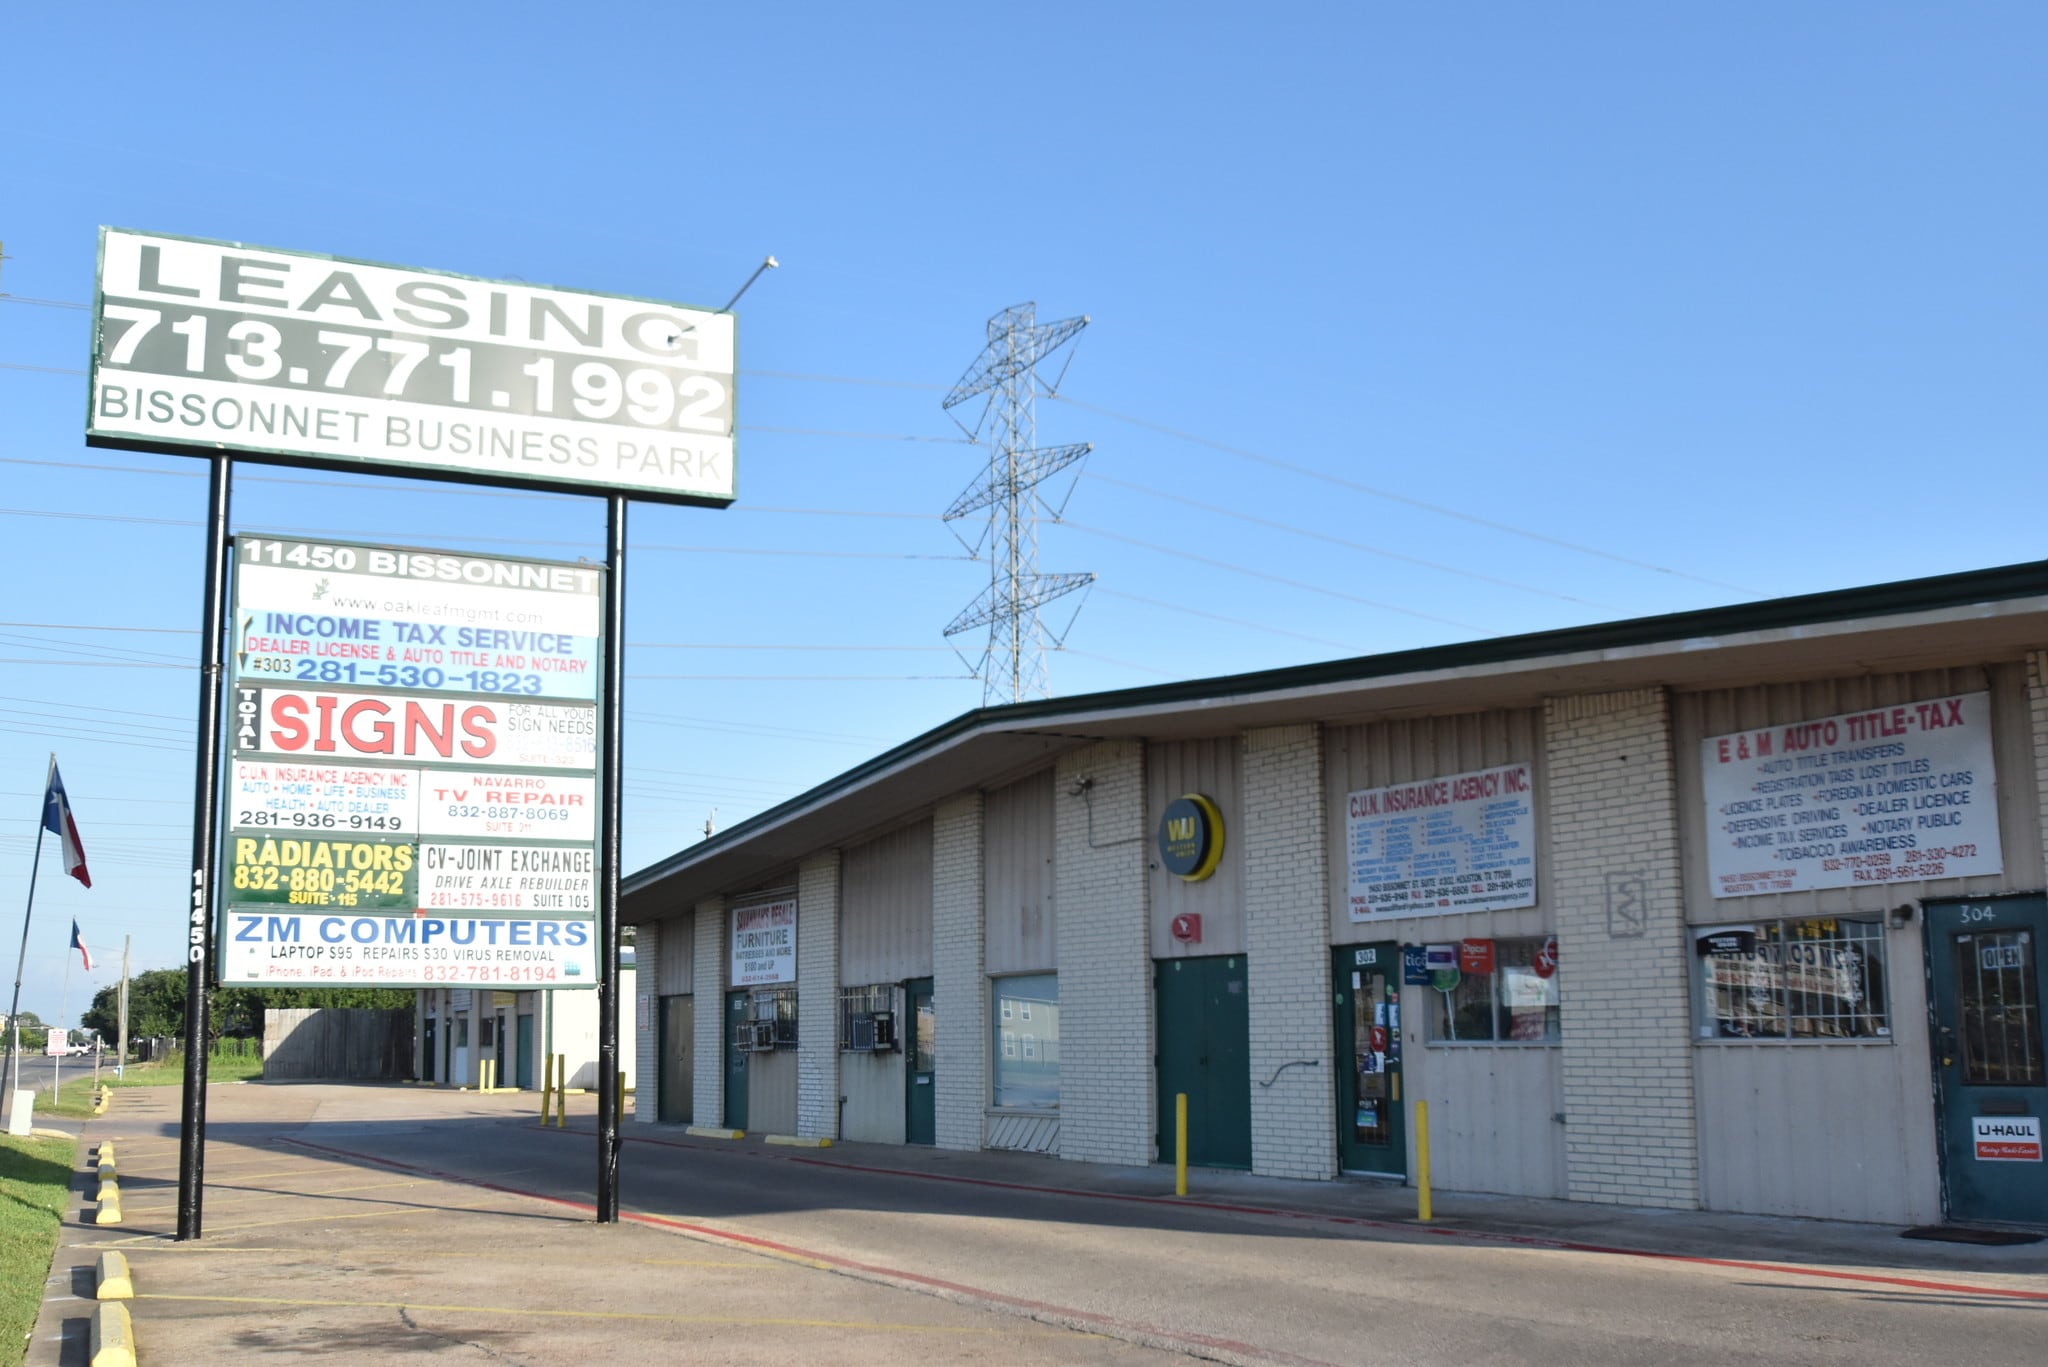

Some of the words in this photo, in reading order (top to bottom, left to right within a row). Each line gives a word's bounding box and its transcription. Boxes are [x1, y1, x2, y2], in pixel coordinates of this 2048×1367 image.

[138, 246, 700, 360] LEASING
[105, 303, 725, 432] 713.771.1992
[99, 386, 368, 445] BISSONNET
[386, 418, 600, 468] BUSINESS
[615, 443, 722, 480] PARK
[243, 541, 356, 570] 11450
[368, 552, 599, 592] BISSONNET
[266, 612, 380, 642] INCOME
[393, 623, 447, 646] TAX
[455, 628, 573, 654] SERVICE
[248, 637, 309, 655] DEALER
[316, 643, 380, 661] LICENSE
[386, 649, 396, 661] &
[403, 648, 443, 664] AUTO
[450, 651, 489, 668] TITLE
[495, 655, 526, 670] AND
[532, 657, 588, 673] NOTARY
[253, 657, 291, 673] #303
[296, 659, 543, 695] 281-530-1823
[239, 689, 256, 750] TOTAL
[508, 704, 531, 716] FOR
[538, 705, 558, 718] ALL
[564, 708, 594, 720] YOUR
[270, 694, 497, 759] SIGNS
[508, 717, 541, 732] SIGN
[549, 719, 594, 735] NEEDS
[1719, 739, 1731, 763] E
[1737, 736, 1751, 759] &
[1757, 732, 1773, 756] M
[1783, 720, 1838, 750] AUTO
[1762, 759, 1793, 774] AUTO
[1796, 754, 1827, 769] TITLE
[1831, 742, 1905, 765] TRANSFERS
[275, 767, 338, 784] INSURANCE
[343, 771, 385, 786] AGENCY
[473, 776, 546, 789] NAVARRO
[1756, 773, 1826, 795] REGISTRATION
[1828, 769, 1854, 786] TAGS
[1860, 763, 1887, 779] LOST
[1892, 757, 1930, 776] TITLES
[1818, 787, 1865, 804] FOREIGN
[1878, 776, 1938, 797] DOMESTIC
[1940, 771, 1974, 787] CARS
[242, 781, 271, 794] AUTO
[281, 783, 313, 796] HOME
[324, 785, 345, 797] LIFE
[356, 786, 407, 800] BUSINESS
[433, 789, 469, 802] TV
[486, 790, 584, 806] REPAIR
[1383, 782, 1449, 814] INSURANCE
[1452, 774, 1500, 803] AGENCY
[1766, 793, 1803, 810] PLATES
[266, 798, 306, 810] HEALTH
[317, 800, 345, 812] AUTO
[348, 801, 390, 814] DEALER
[448, 805, 569, 821] 832-887-8069
[1858, 799, 1910, 817] DEALER
[239, 810, 403, 831] 281-936-9149
[485, 821, 513, 833] SUITE
[1727, 815, 1787, 835] DEFENSIVE
[1791, 807, 1841, 827] DRIVING
[1866, 818, 1913, 835] NOTARY
[1917, 811, 1962, 829] PUBLIC
[1737, 833, 1775, 850] INCOME
[1778, 831, 1796, 846] TAX
[1798, 824, 1848, 844] SERVICES
[1778, 843, 1836, 862] TOBACCO
[1840, 834, 1917, 855] AWARENESS
[236, 838, 413, 871] RADIATORS
[427, 847, 503, 871] CV-JOINT
[511, 850, 591, 873] EXCHANGE
[234, 865, 406, 895] 832-880-5442
[435, 875, 474, 889] DRIVE
[480, 876, 513, 890] AXLE
[520, 877, 589, 891] REBUILDER
[289, 891, 329, 905] SUITE
[337, 893, 358, 906] 115
[533, 894, 563, 907] SUITE
[569, 895, 590, 908] 105
[189, 869, 205, 962] 11450
[1960, 905, 1997, 923] 304
[235, 916, 301, 943] ZM
[319, 916, 588, 946] COMPUTERS
[737, 929, 788, 950] FURNITURE
[271, 945, 325, 959] LAPTOP
[363, 946, 419, 960] REPAIRS
[453, 949, 492, 961] VIRUS
[496, 949, 555, 962] REMOVAL
[423, 966, 557, 982] 832-781-8194
[1978, 1125, 2036, 1136] U-HAUL
